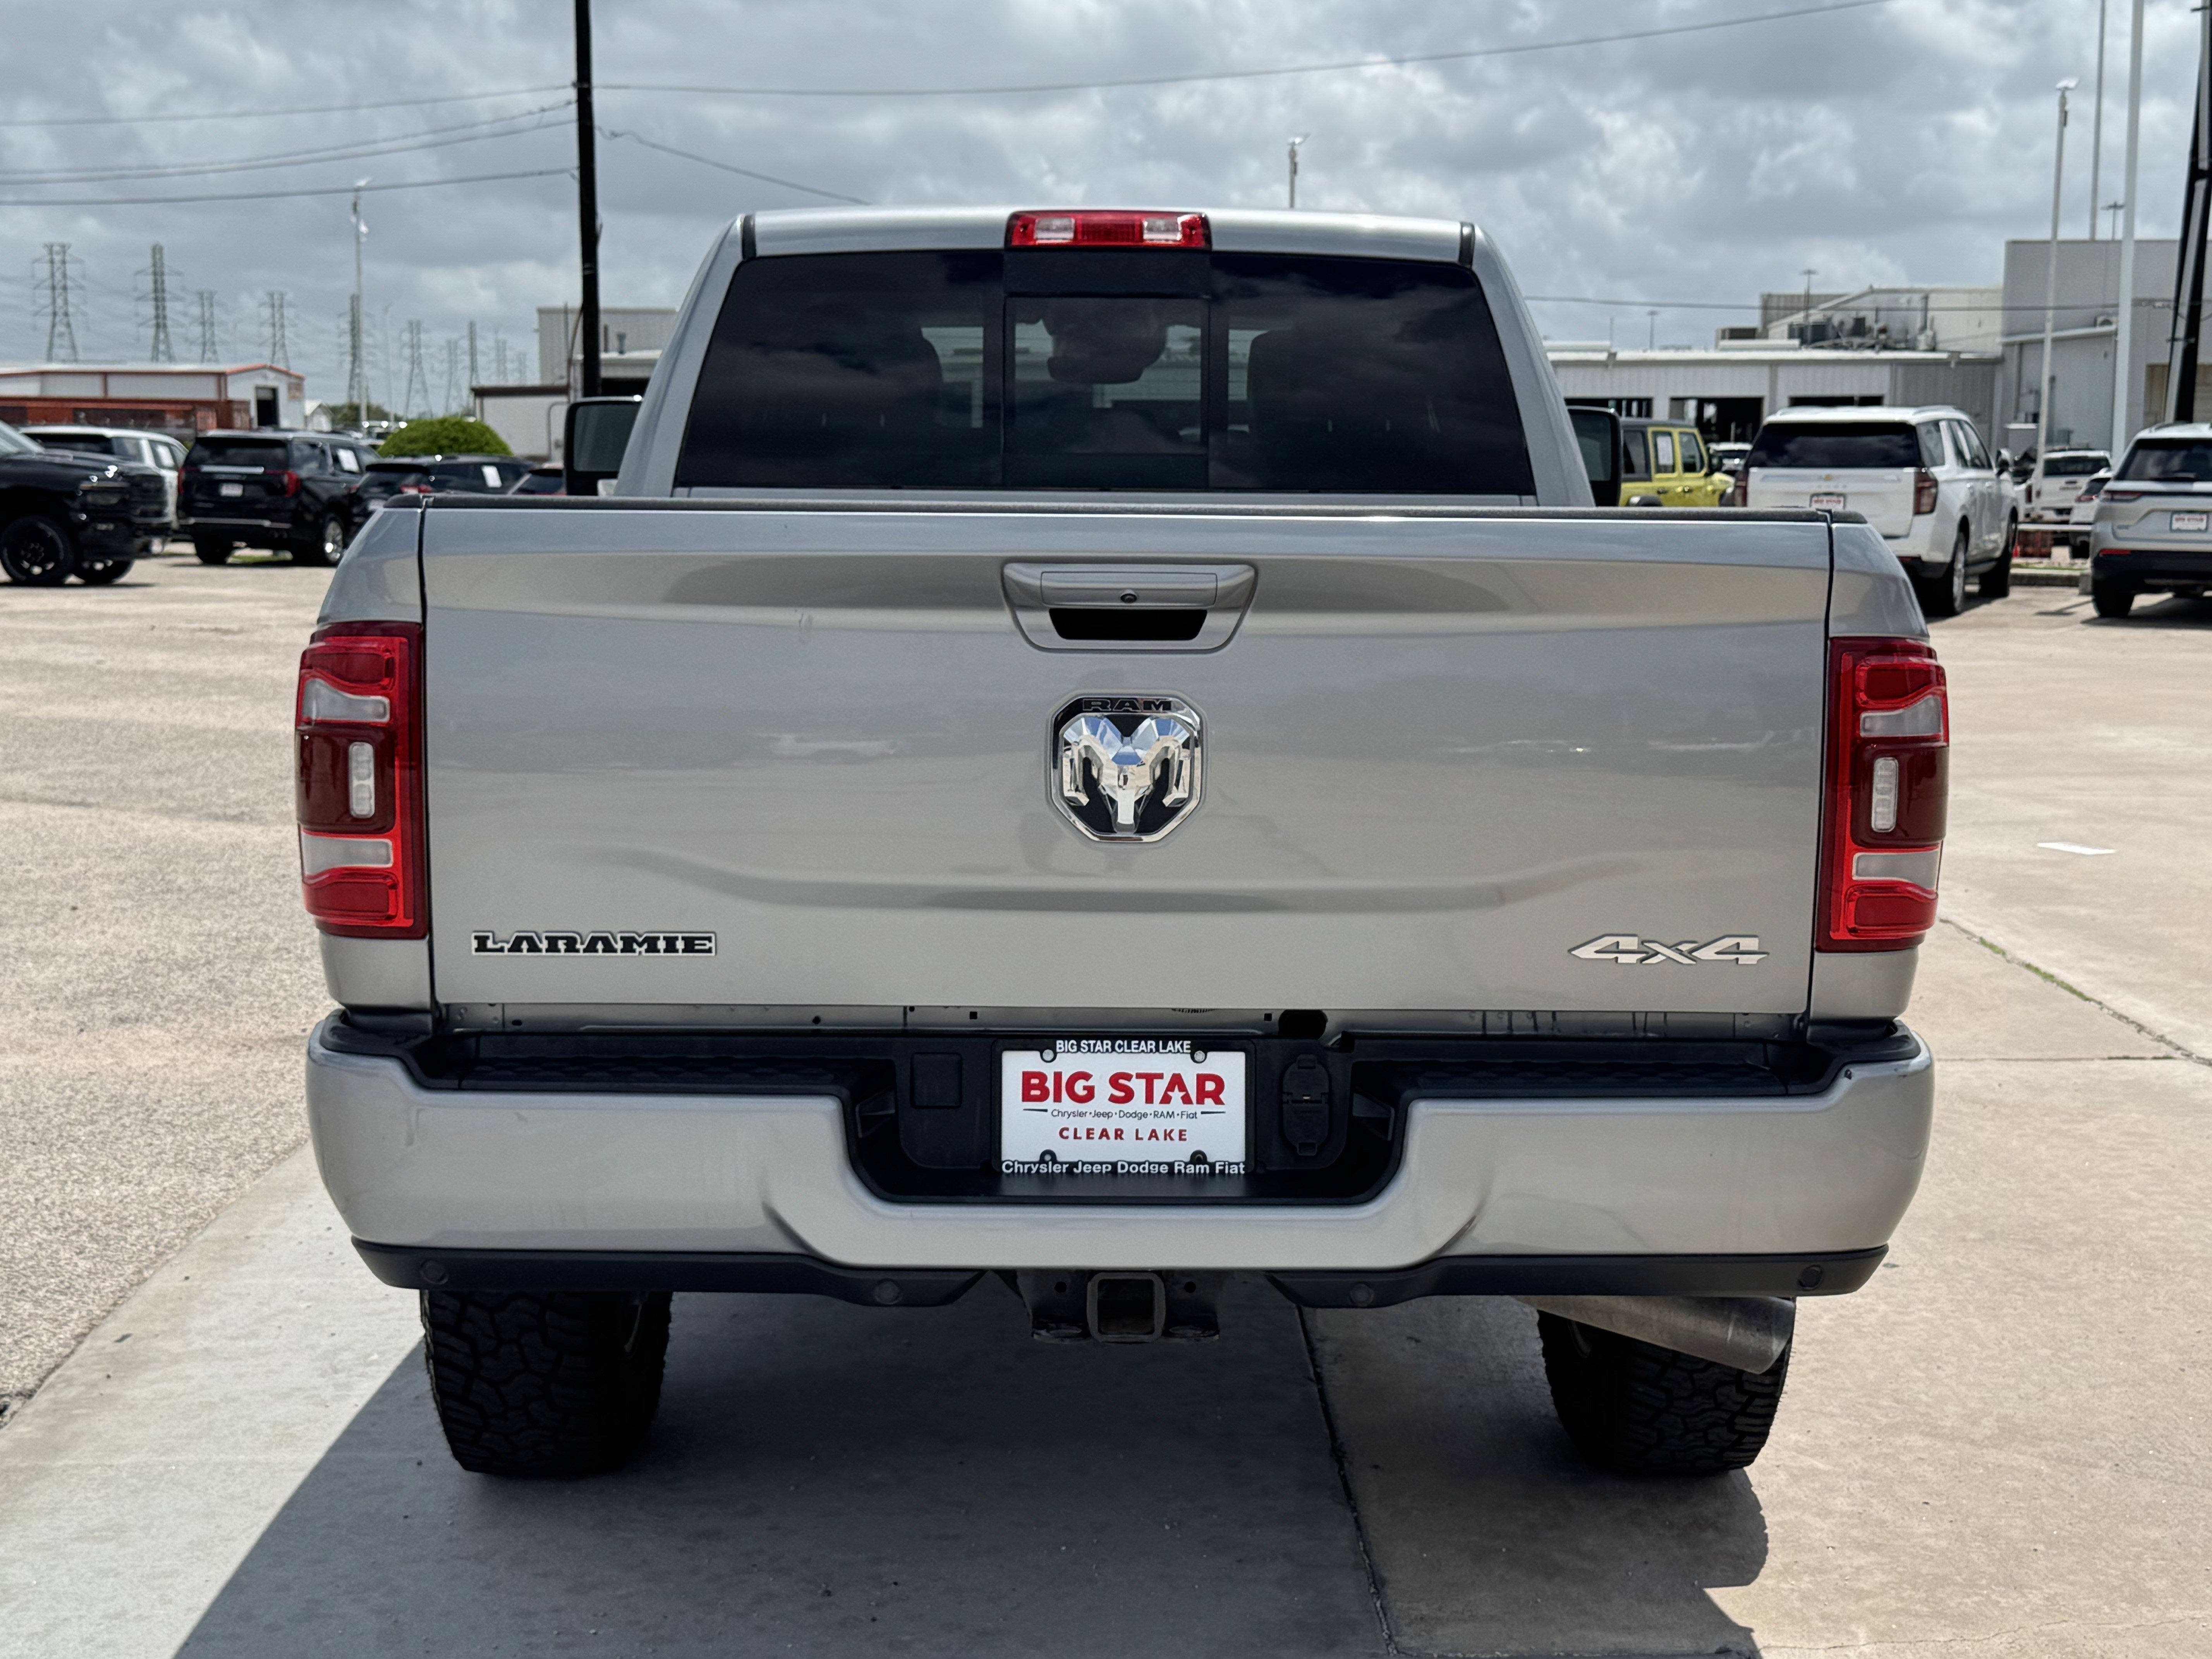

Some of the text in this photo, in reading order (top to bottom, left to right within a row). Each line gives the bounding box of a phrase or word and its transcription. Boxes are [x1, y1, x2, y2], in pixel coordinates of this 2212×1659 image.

[1082, 698, 1172, 711] RAM
[472, 931, 716, 956] LARAMIE
[1056, 1039, 1191, 1053] BIG STAR CLEAR LAKE
[1021, 1070, 1225, 1105] BIG STAR
[1051, 1109, 1197, 1120] Chrysler Jeep Dodge RAM Fiat
[1058, 1127, 1187, 1142] CLEAR LAKE
[1001, 1161, 1245, 1174] Chrysler Jeep Dodge Ram Fiat
